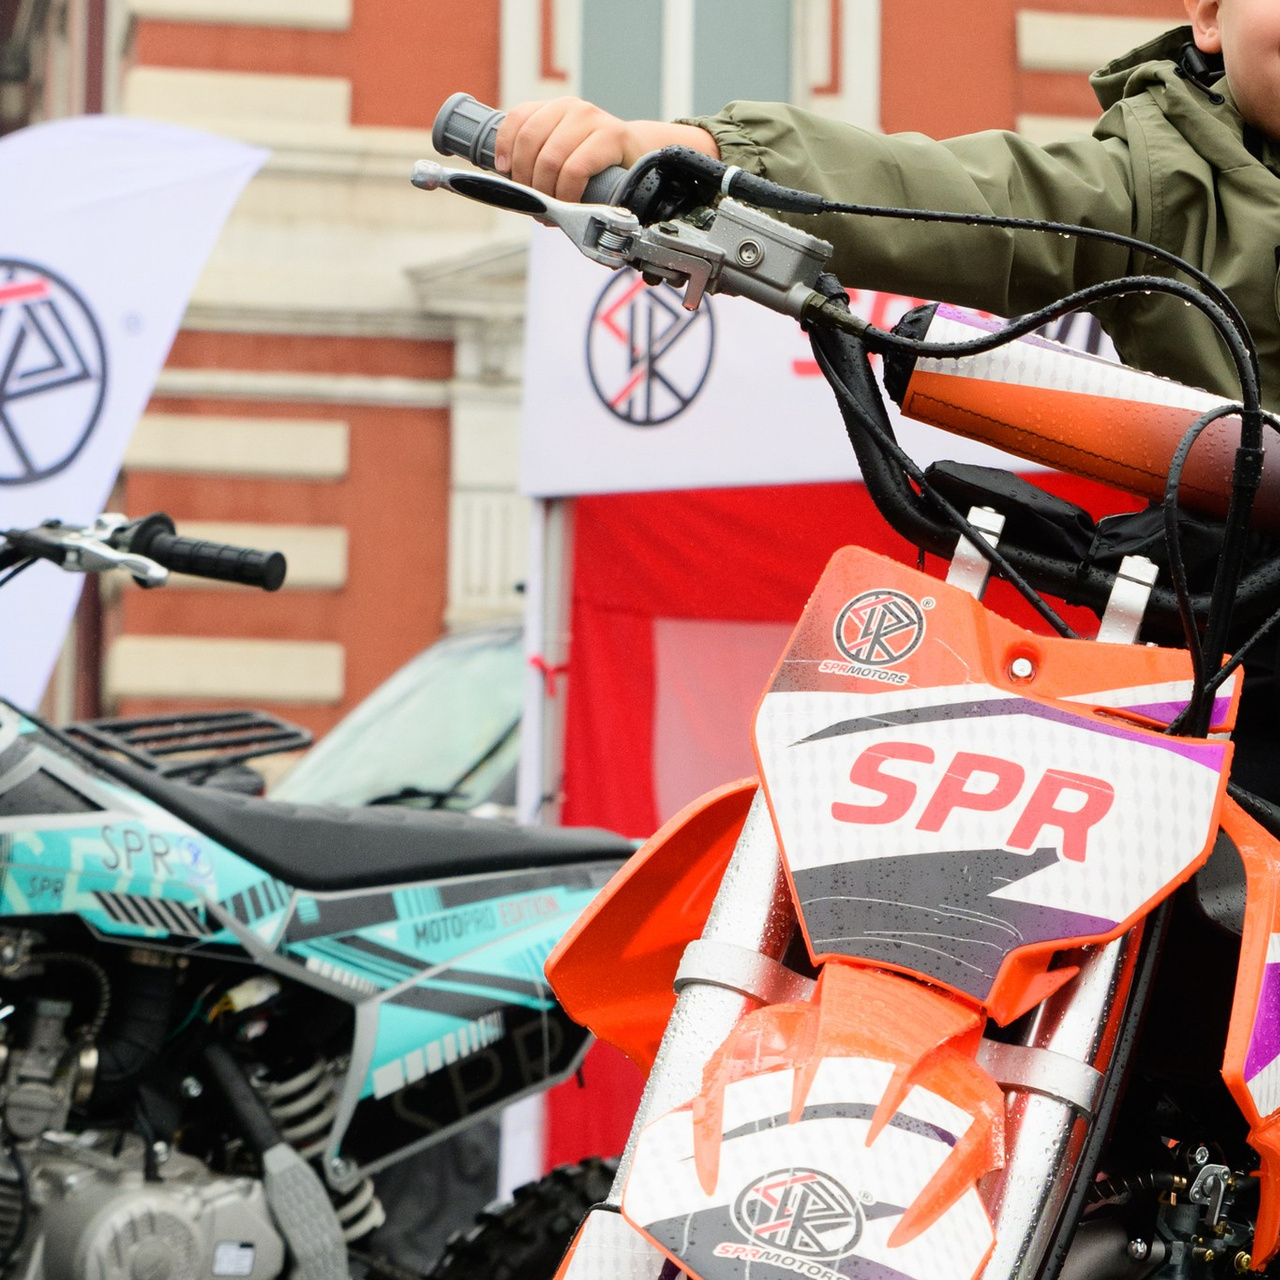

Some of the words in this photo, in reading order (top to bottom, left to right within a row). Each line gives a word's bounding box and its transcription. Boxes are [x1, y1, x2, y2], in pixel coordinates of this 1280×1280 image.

[818, 660, 908, 685] SPRMOTORS
[830, 741, 1116, 863] SPR
[100, 823, 176, 877] SPR
